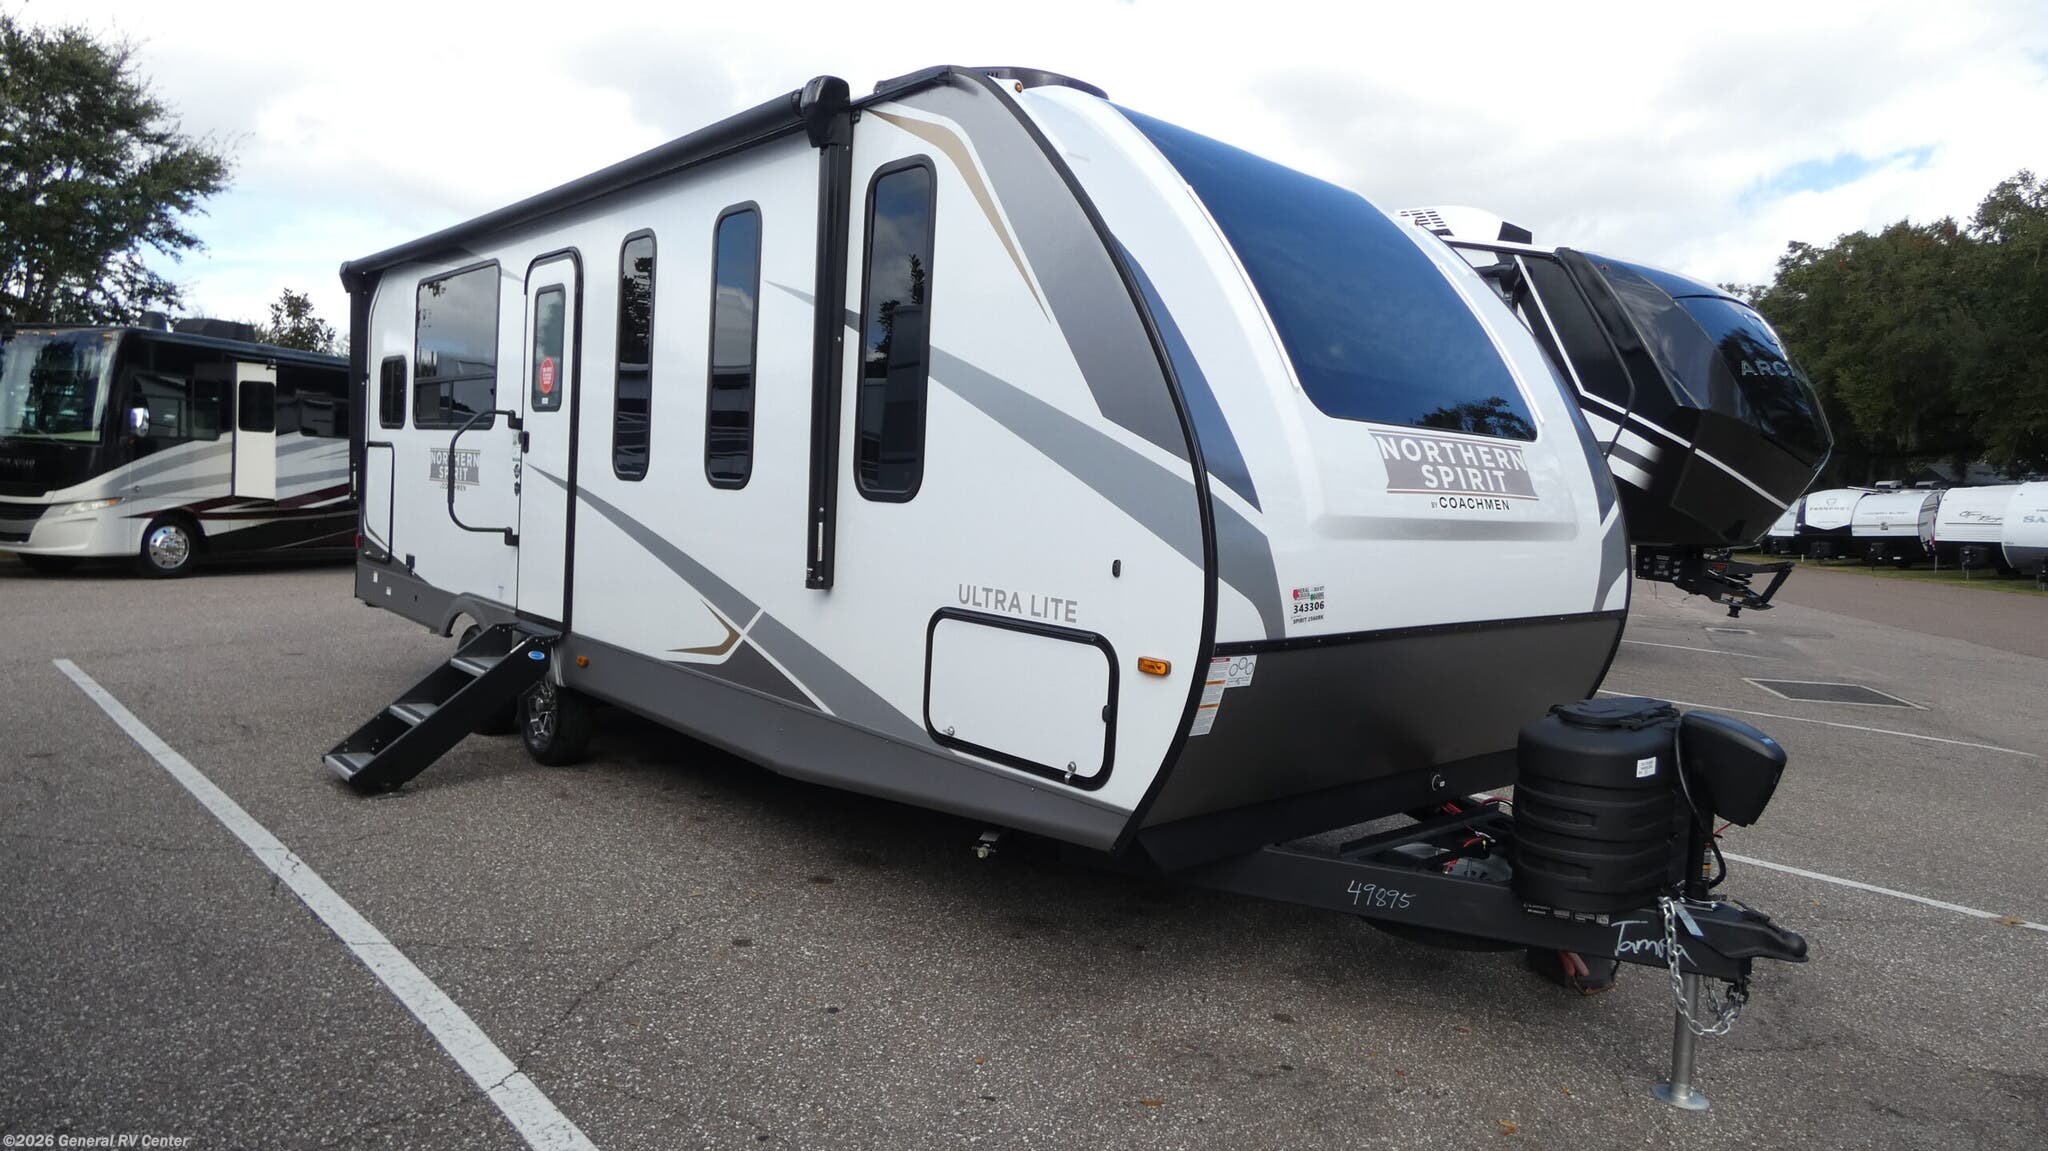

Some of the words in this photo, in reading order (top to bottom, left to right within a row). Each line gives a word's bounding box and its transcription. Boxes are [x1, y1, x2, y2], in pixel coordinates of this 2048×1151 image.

[431, 451, 480, 468] NORHERN
[1375, 436, 1527, 472] NORTHERN
[438, 465, 469, 482] SPRIT
[1421, 464, 1507, 493] SPIRIT
[1438, 496, 1511, 511] COACHMEN
[958, 583, 1023, 615] ULTRA
[1030, 594, 1078, 625] LITE
[1293, 600, 1325, 614] 343306
[1347, 880, 1417, 909] 49895
